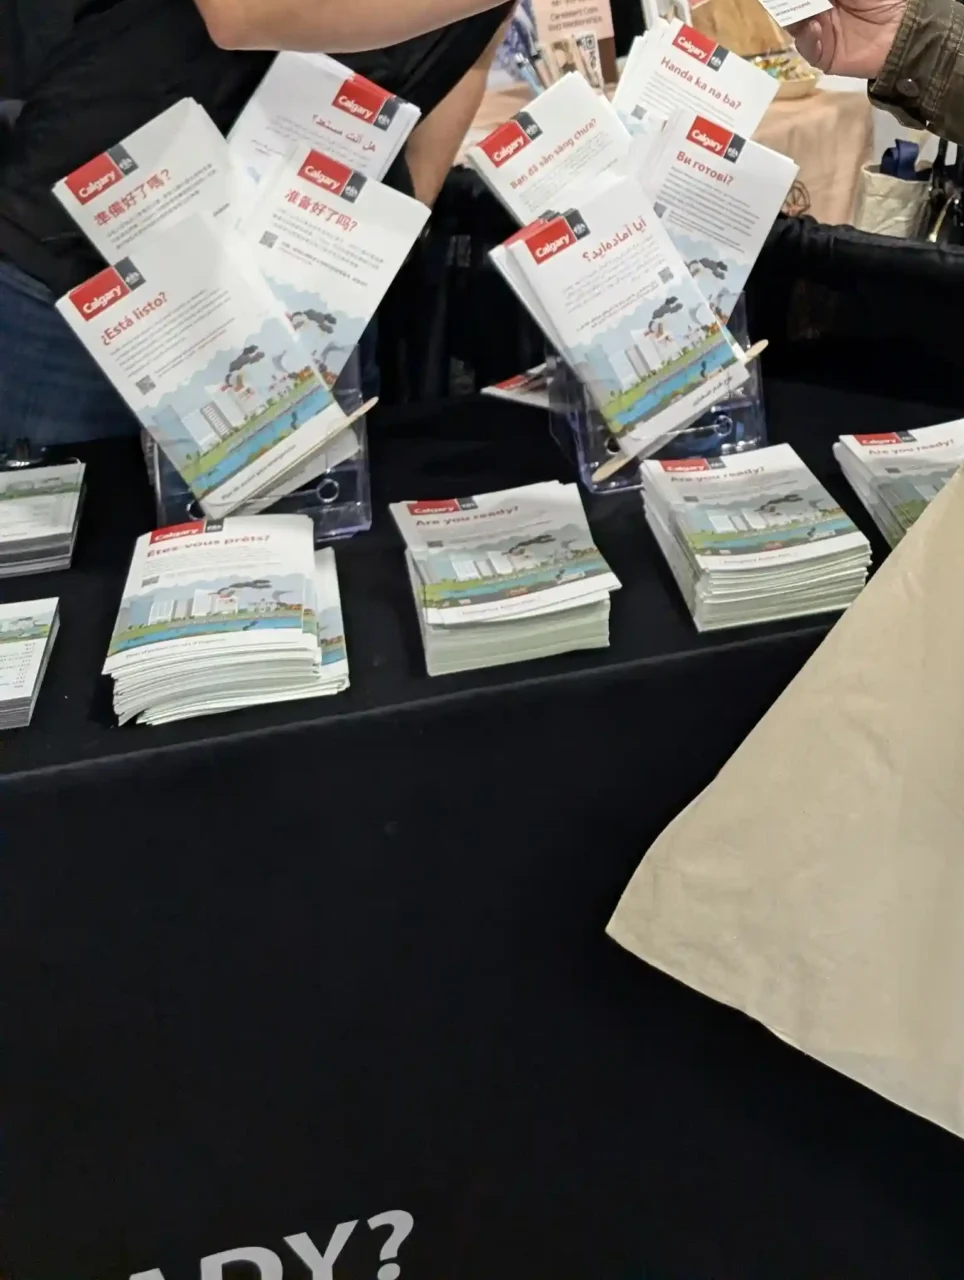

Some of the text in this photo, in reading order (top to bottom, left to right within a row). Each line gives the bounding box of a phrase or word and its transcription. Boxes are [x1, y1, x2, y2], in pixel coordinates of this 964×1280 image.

[677, 36, 707, 59] Calgary
[660, 56, 742, 111] Handa ka na ba?
[338, 95, 374, 119] Calgary
[493, 136, 525, 162] Calgary
[691, 129, 723, 152] Calgary
[305, 165, 340, 190] Calgary
[676, 151, 734, 187] Ви готові?
[78, 170, 117, 198] Calgary
[535, 234, 570, 258] Calgary
[82, 284, 122, 314] Calgary
[101, 291, 168, 346] ¿Está listo?
[670, 466, 765, 483] Are you ready?
[413, 505, 455, 515] Calgary
[416, 505, 519, 527] Are you ready?
[154, 527, 199, 542] Calgary
